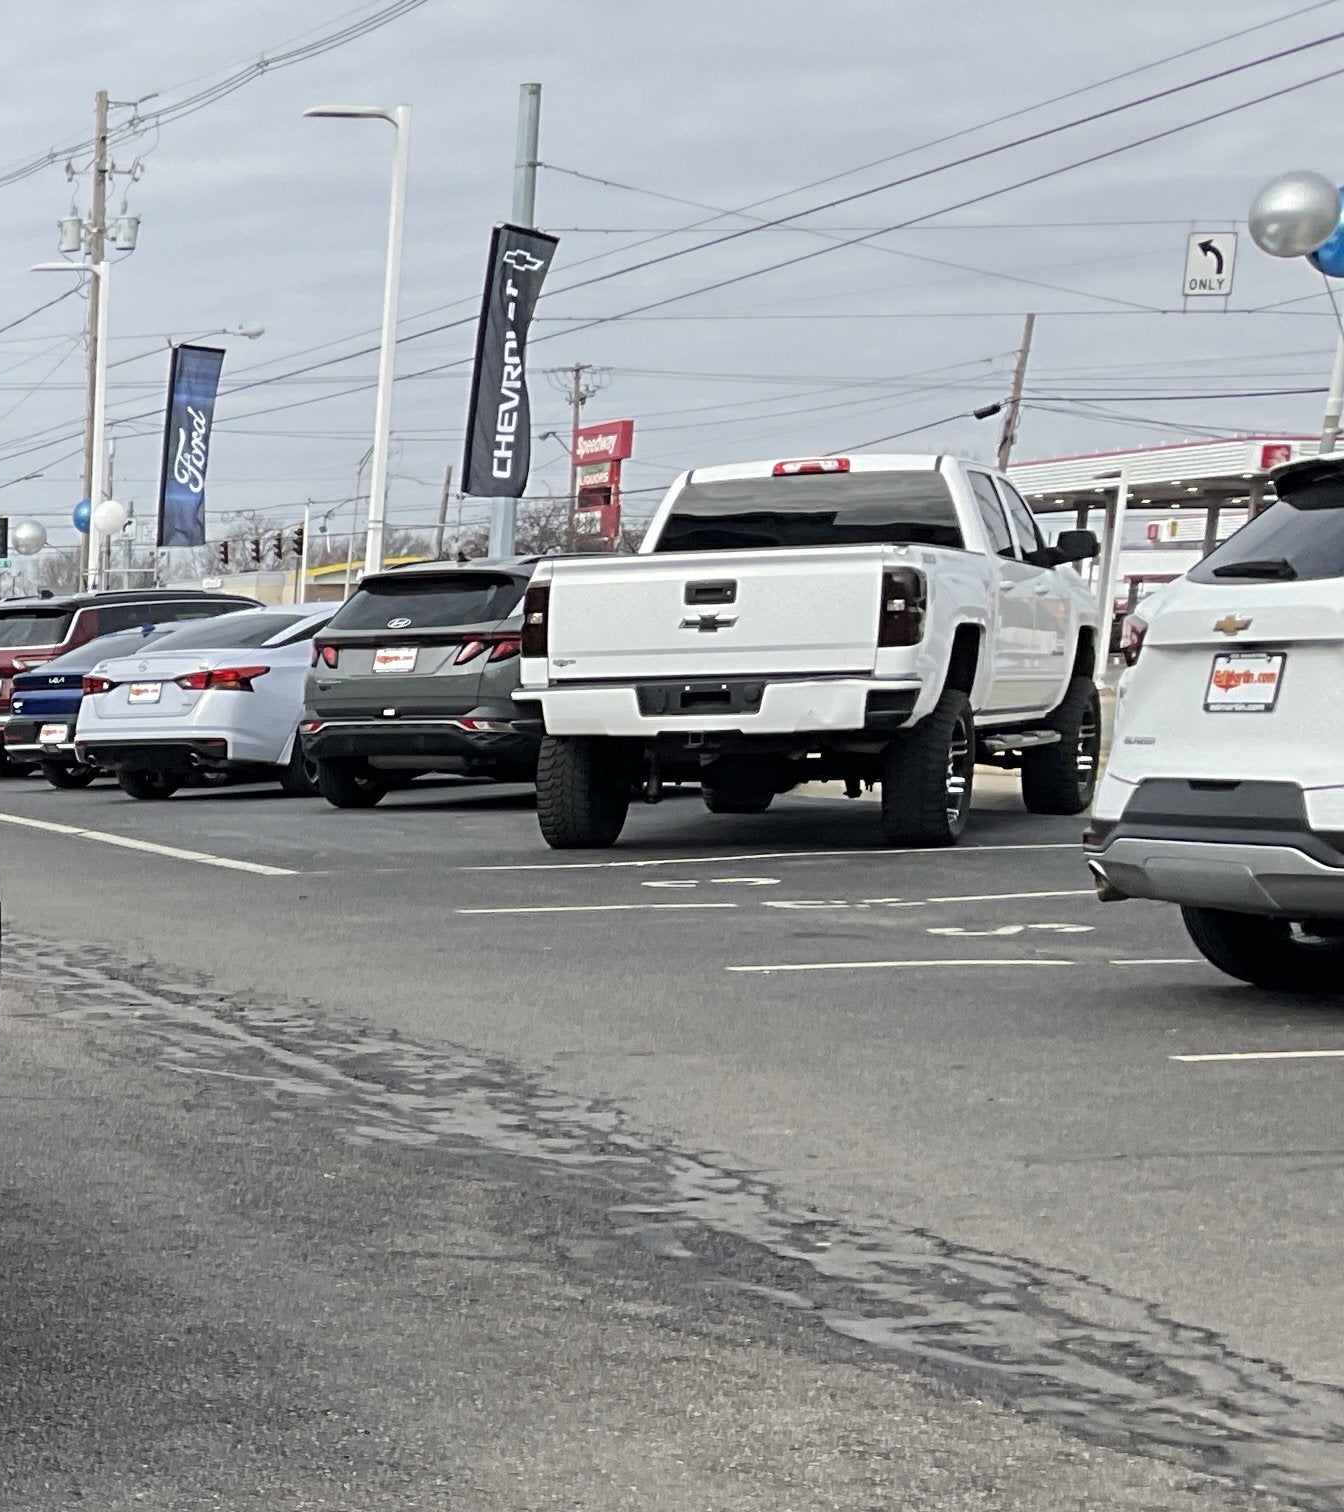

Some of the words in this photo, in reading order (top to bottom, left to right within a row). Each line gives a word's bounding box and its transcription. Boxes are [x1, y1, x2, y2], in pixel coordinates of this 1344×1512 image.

[1189, 278, 1225, 291] ONLY
[175, 406, 206, 493] Ford
[576, 433, 617, 460] Speedway
